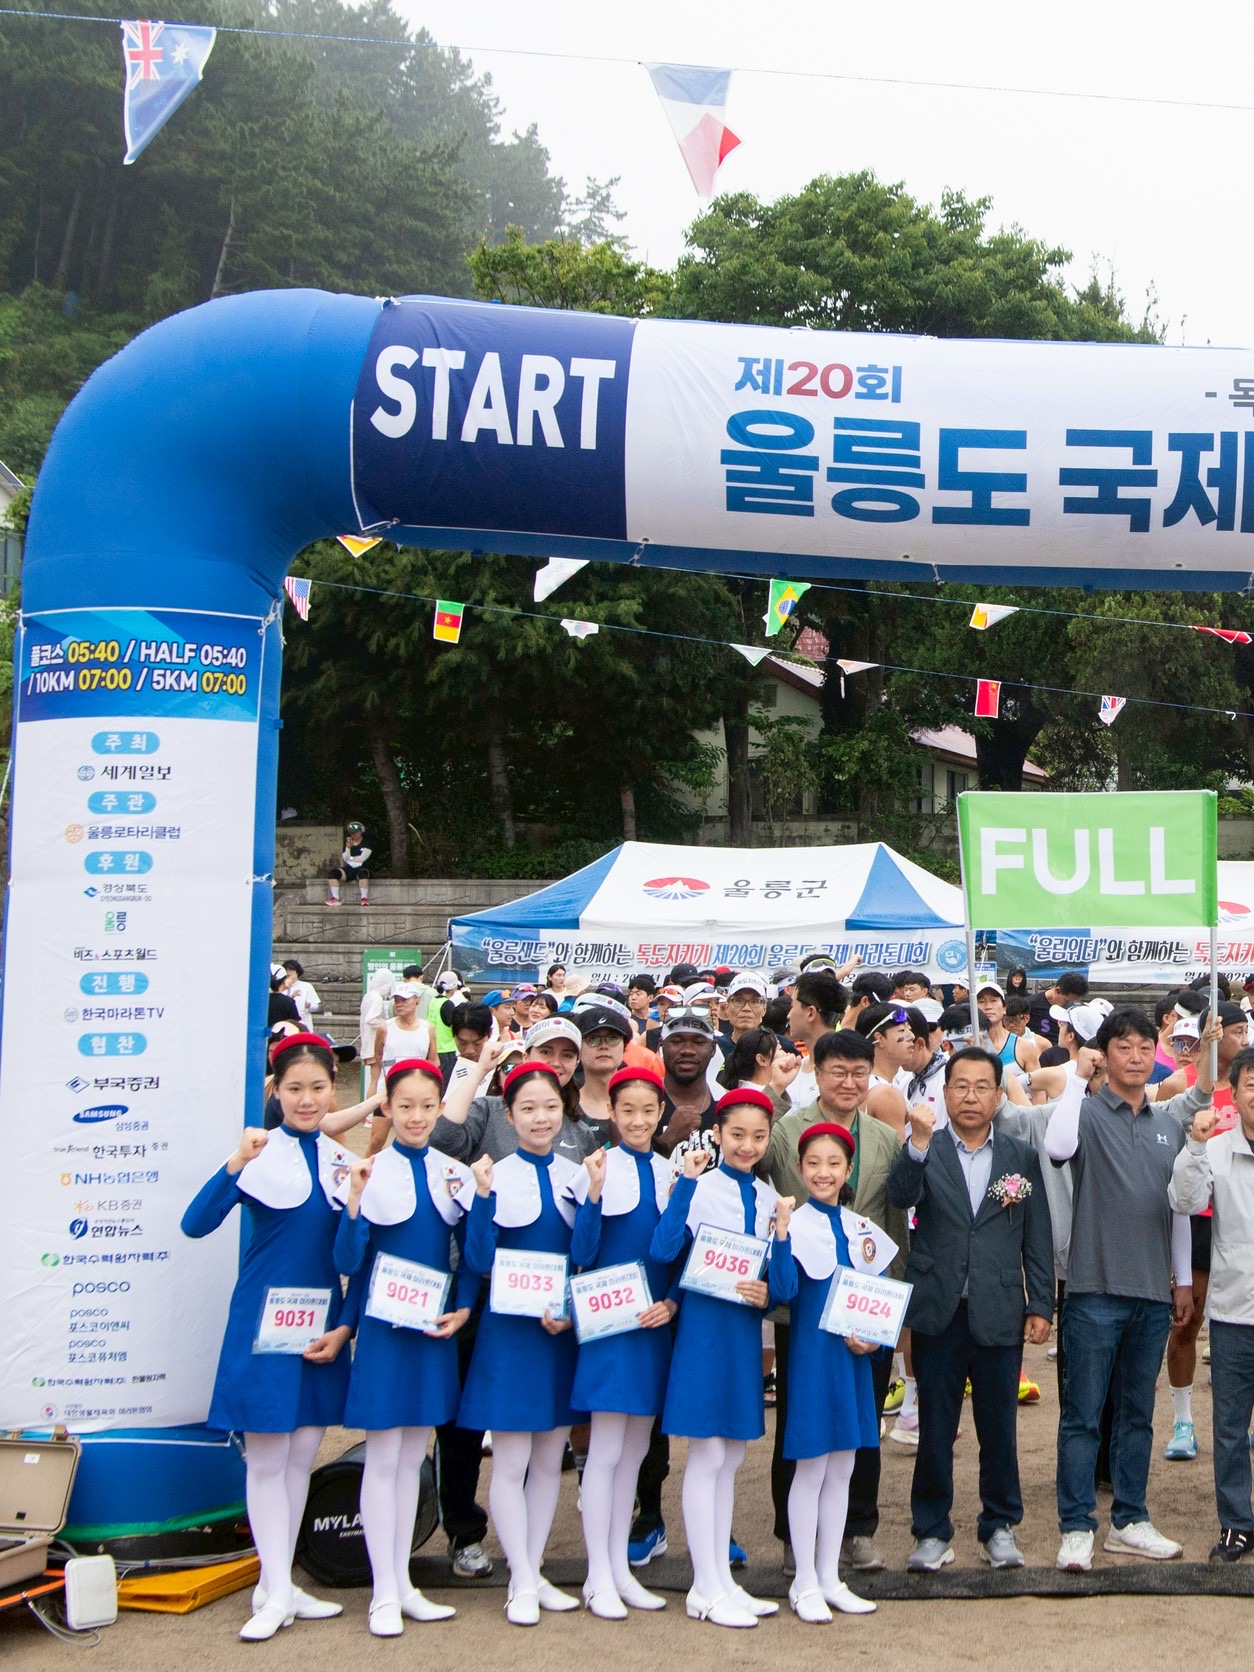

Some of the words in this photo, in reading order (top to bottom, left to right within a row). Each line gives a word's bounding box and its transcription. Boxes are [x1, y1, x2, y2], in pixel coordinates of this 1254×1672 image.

[734, 356, 903, 404] 제20회
[370, 344, 616, 450] START
[720, 409, 1030, 526] 울릉도
[30, 645, 64, 666] 풀코스
[67, 641, 119, 663] 05:40
[123, 640, 136, 663] /
[140, 643, 197, 664] HALF
[200, 645, 246, 667] 05:40
[78, 668, 131, 690] 07:00
[136, 668, 148, 690] /
[152, 670, 197, 691] 5KM
[201, 672, 246, 695] 07:00
[101, 765, 172, 780] 세계일보
[87, 825, 181, 839] 울릉로타리클럽
[980, 827, 1196, 896] FULL
[103, 884, 148, 893] 경상북도
[723, 879, 828, 899] 울릉군
[104, 911, 127, 931] 울릉
[575, 943, 632, 966] 함께하는
[637, 944, 709, 966] 독도지키기
[713, 944, 764, 966] 제20회
[853, 942, 929, 966] 마라톤대회
[1127, 940, 1189, 963] 함께하는
[590, 973, 611, 983] 일시
[82, 1007, 164, 1021] 한국마라톤TV
[93, 1077, 160, 1091] 부국증권
[79, 1110, 123, 1119] SAMSUNG
[116, 1121, 149, 1131] 삼성증권
[93, 1145, 146, 1159] 한국투자
[75, 1170, 159, 1185] NH농협은행
[97, 1199, 142, 1211] KB증권
[91, 1225, 143, 1238] 연합뉴스
[704, 1250, 749, 1275] 9036
[73, 1281, 130, 1297] posco
[508, 1273, 554, 1291] 9033
[387, 1282, 428, 1307] 9021
[589, 1287, 635, 1312] 9032
[70, 1308, 108, 1318] posco
[847, 1294, 891, 1318] 9024
[68, 1320, 130, 1333] 포스코이앤씨
[274, 1310, 315, 1327] 9031
[69, 1339, 107, 1349] posco
